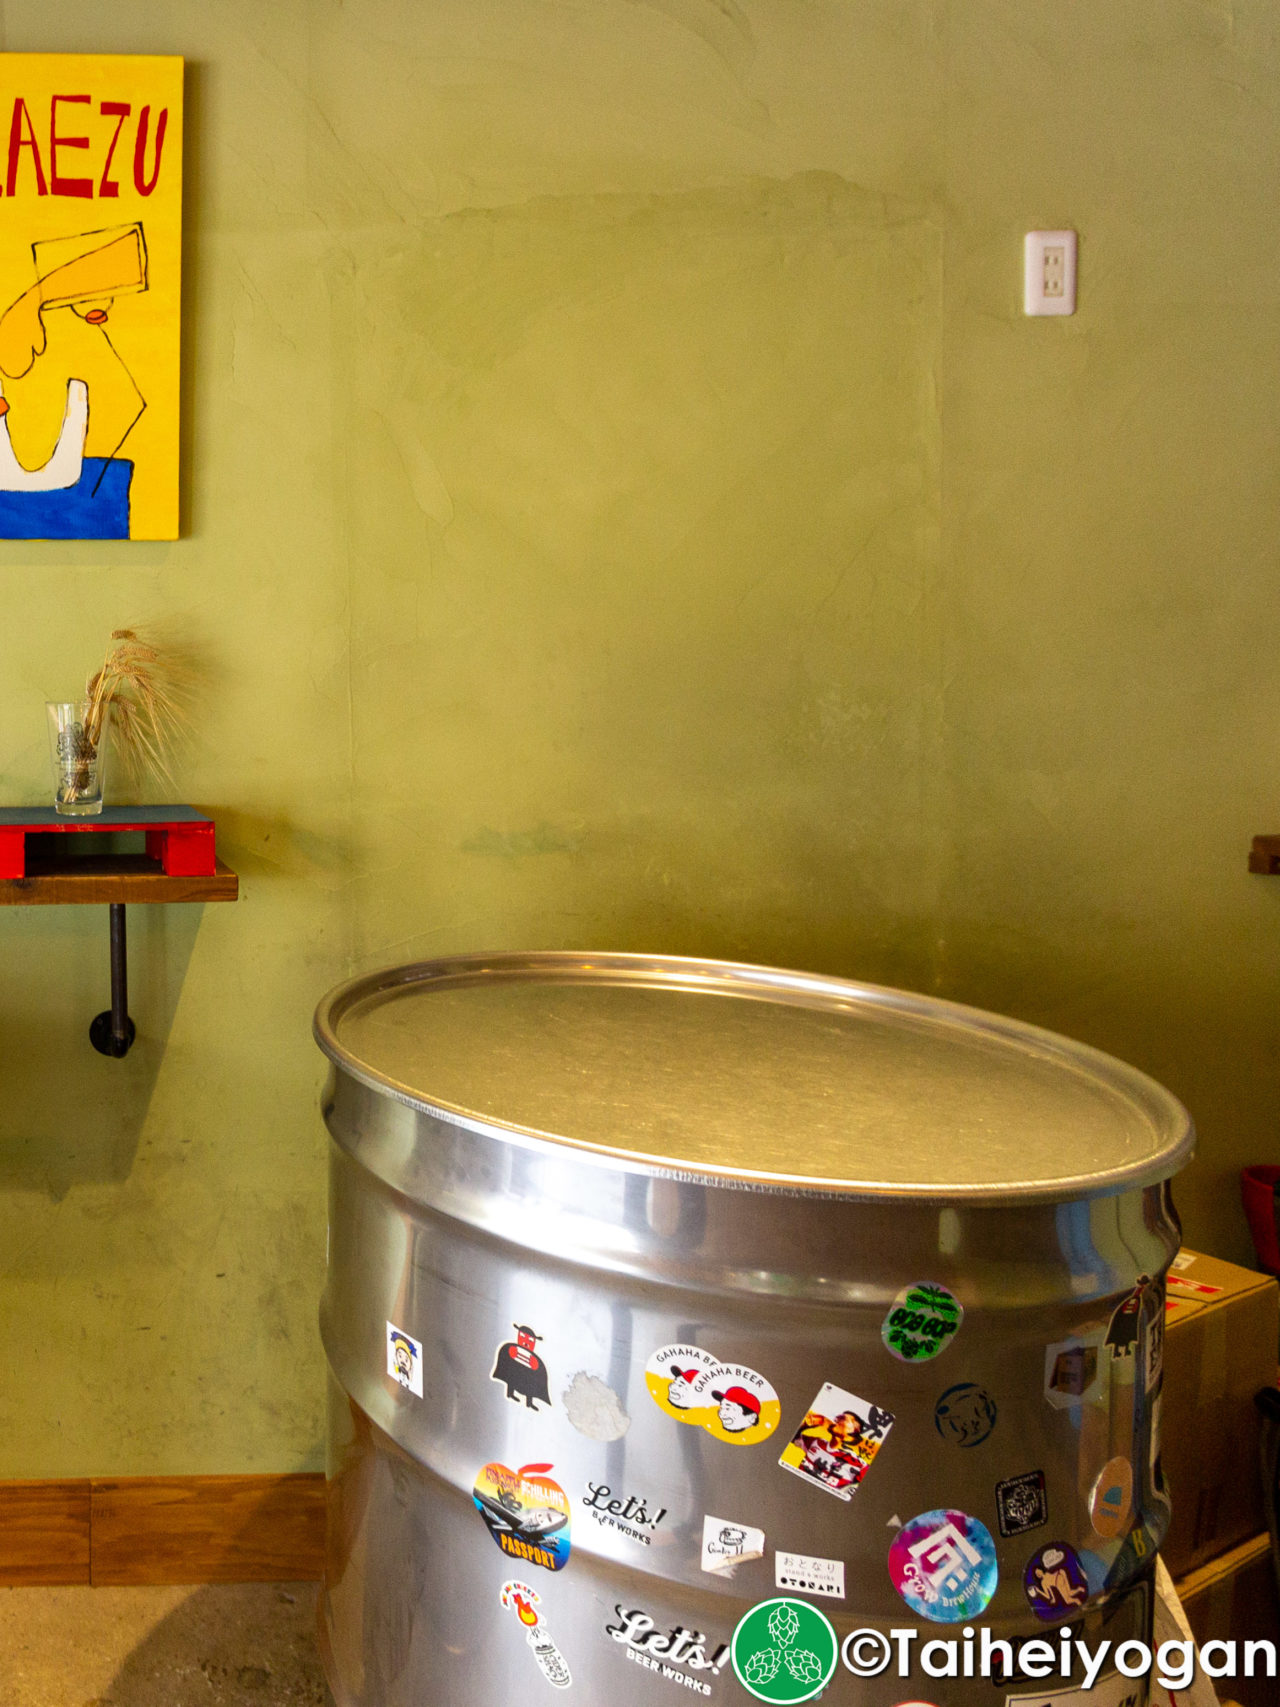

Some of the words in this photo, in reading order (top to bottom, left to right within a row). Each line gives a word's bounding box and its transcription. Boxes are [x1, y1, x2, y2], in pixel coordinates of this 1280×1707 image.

[656, 1348, 701, 1363] GAHAHA
[703, 1356, 718, 1367] BE
[694, 1367, 732, 1393] GAHAHA
[735, 1367, 764, 1388] BEER
[582, 1482, 667, 1530] Let's!
[592, 1510, 615, 1527] BEER
[617, 1522, 651, 1545] WORKS
[500, 1533, 556, 1569] PASSPORT
[607, 1605, 730, 1675] Let's!
[626, 1647, 661, 1673] BEER
[662, 1664, 712, 1696] WORKS
